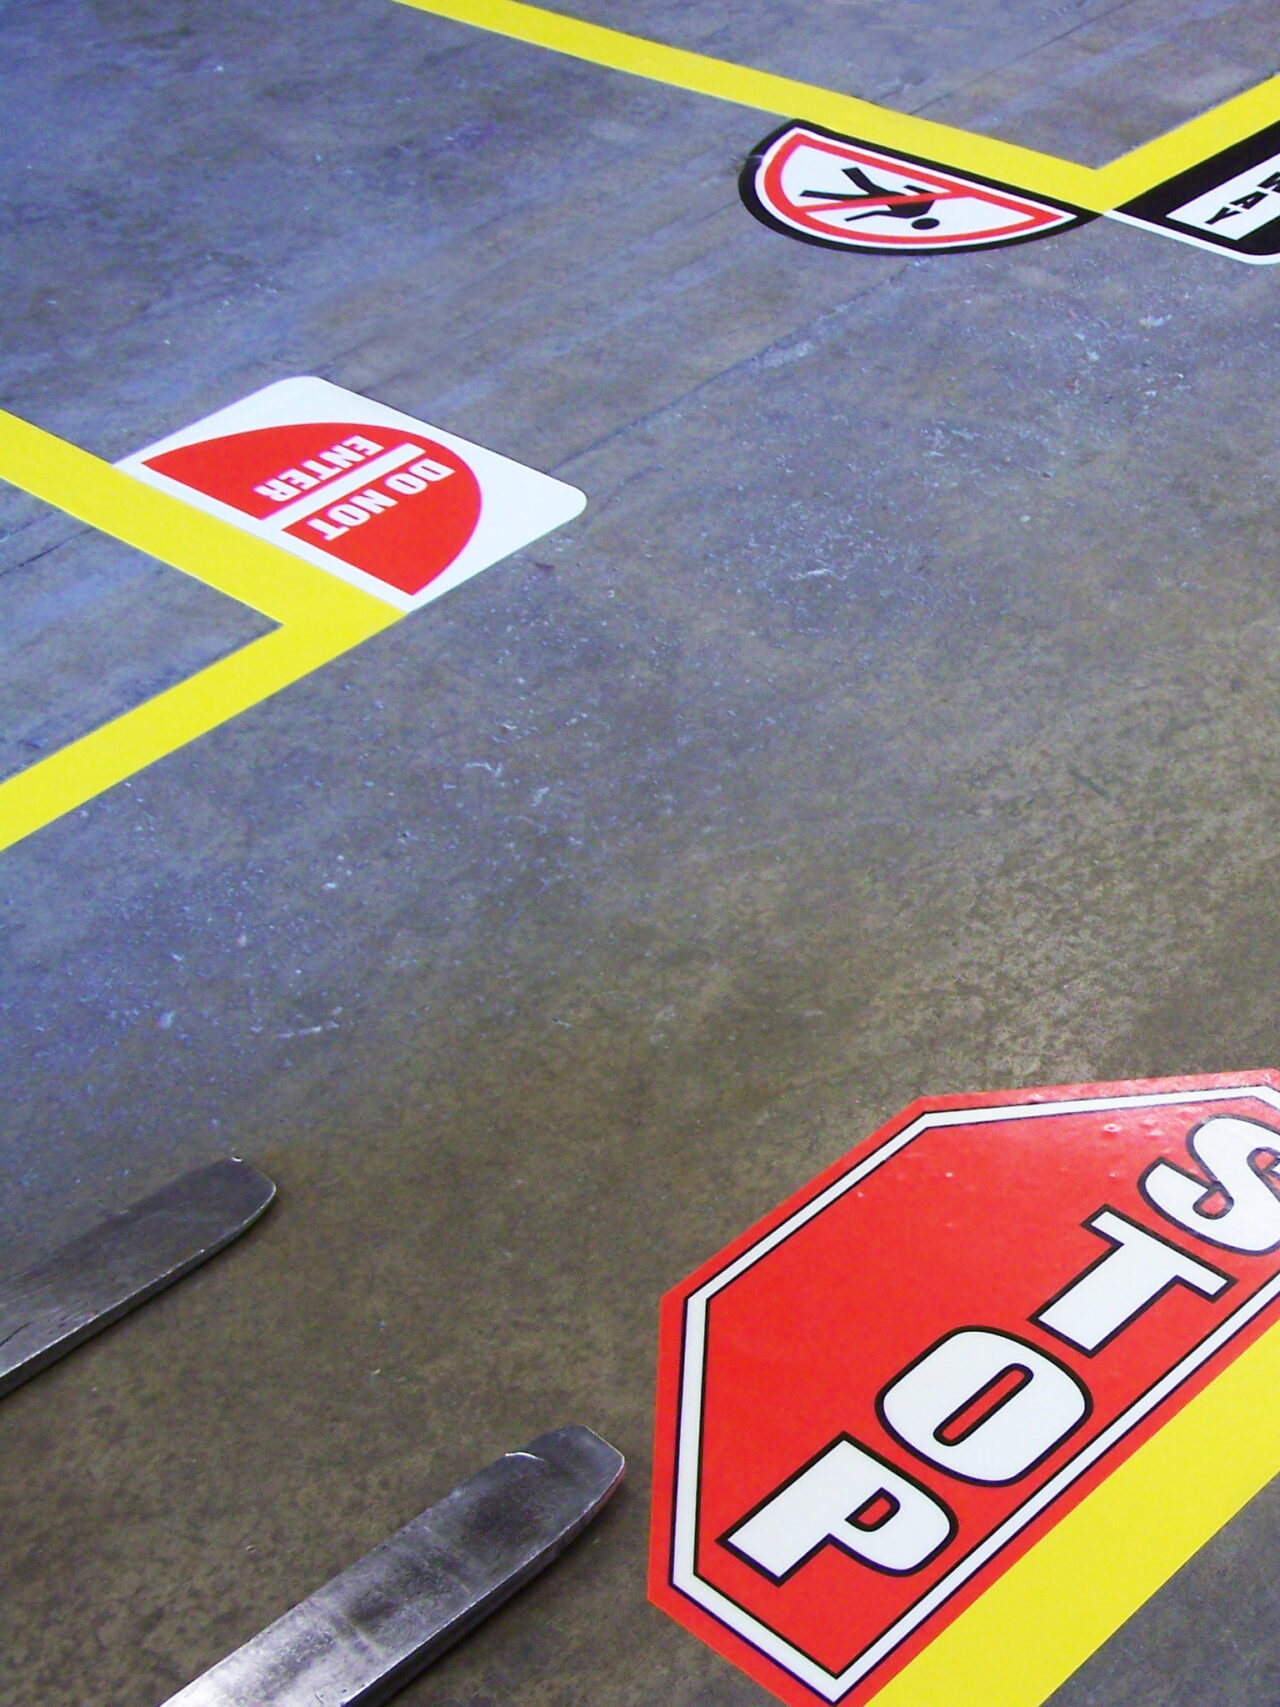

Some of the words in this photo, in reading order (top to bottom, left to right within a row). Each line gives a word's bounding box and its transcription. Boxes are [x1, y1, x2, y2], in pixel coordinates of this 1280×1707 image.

[253, 435, 385, 503] ENTER
[384, 457, 456, 496] DO
[306, 489, 399, 541] NOT
